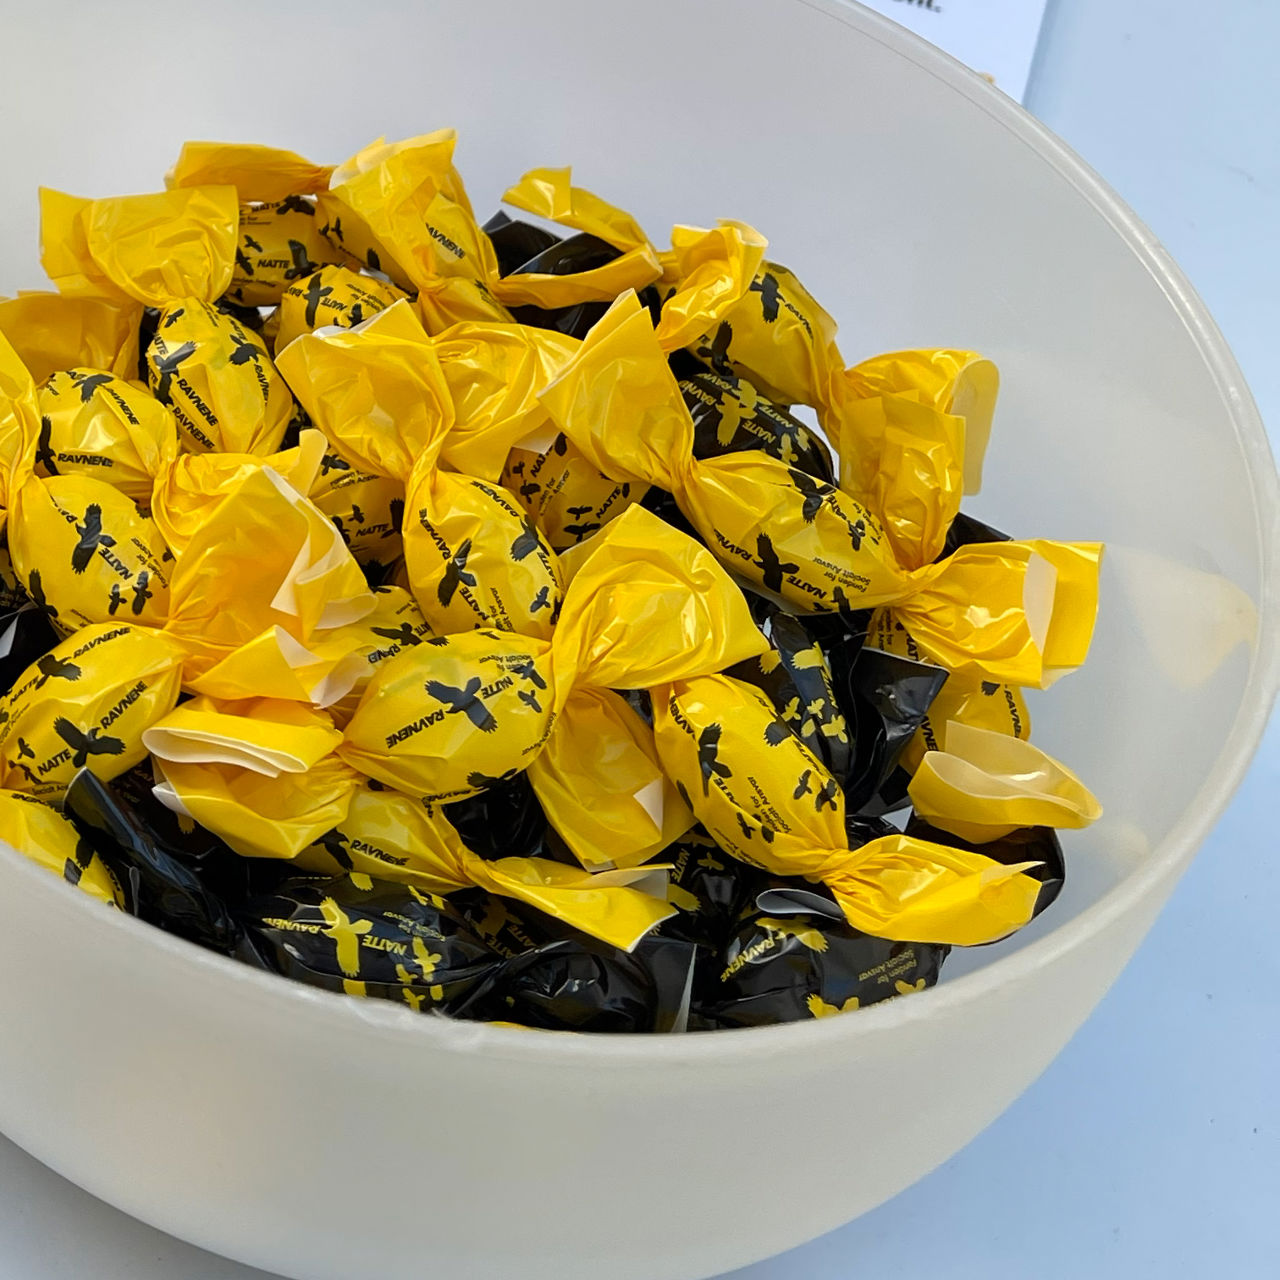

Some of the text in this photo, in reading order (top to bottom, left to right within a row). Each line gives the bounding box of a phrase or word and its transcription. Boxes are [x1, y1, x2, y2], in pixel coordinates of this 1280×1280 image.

[425, 222, 466, 259] AVNENE
[257, 259, 290, 269] NATTE
[176, 378, 219, 427] RAVNENE
[172, 406, 215, 450] RAVNENE
[742, 420, 776, 443] NATTE
[57, 453, 114, 468] RAVNENE
[98, 547, 134, 580] NATTE
[418, 508, 491, 621] NATTE RAVNENE
[812, 556, 841, 573] Ansvar
[786, 575, 827, 600] NATTE
[823, 571, 868, 594] Fonden for
[73, 626, 131, 659] RAVNENE
[35, 680, 148, 776] NATTE RAVNENE
[385, 709, 445, 749] RAVNENE
[362, 934, 408, 957] NATTE
[720, 934, 776, 984] RAVNENE
